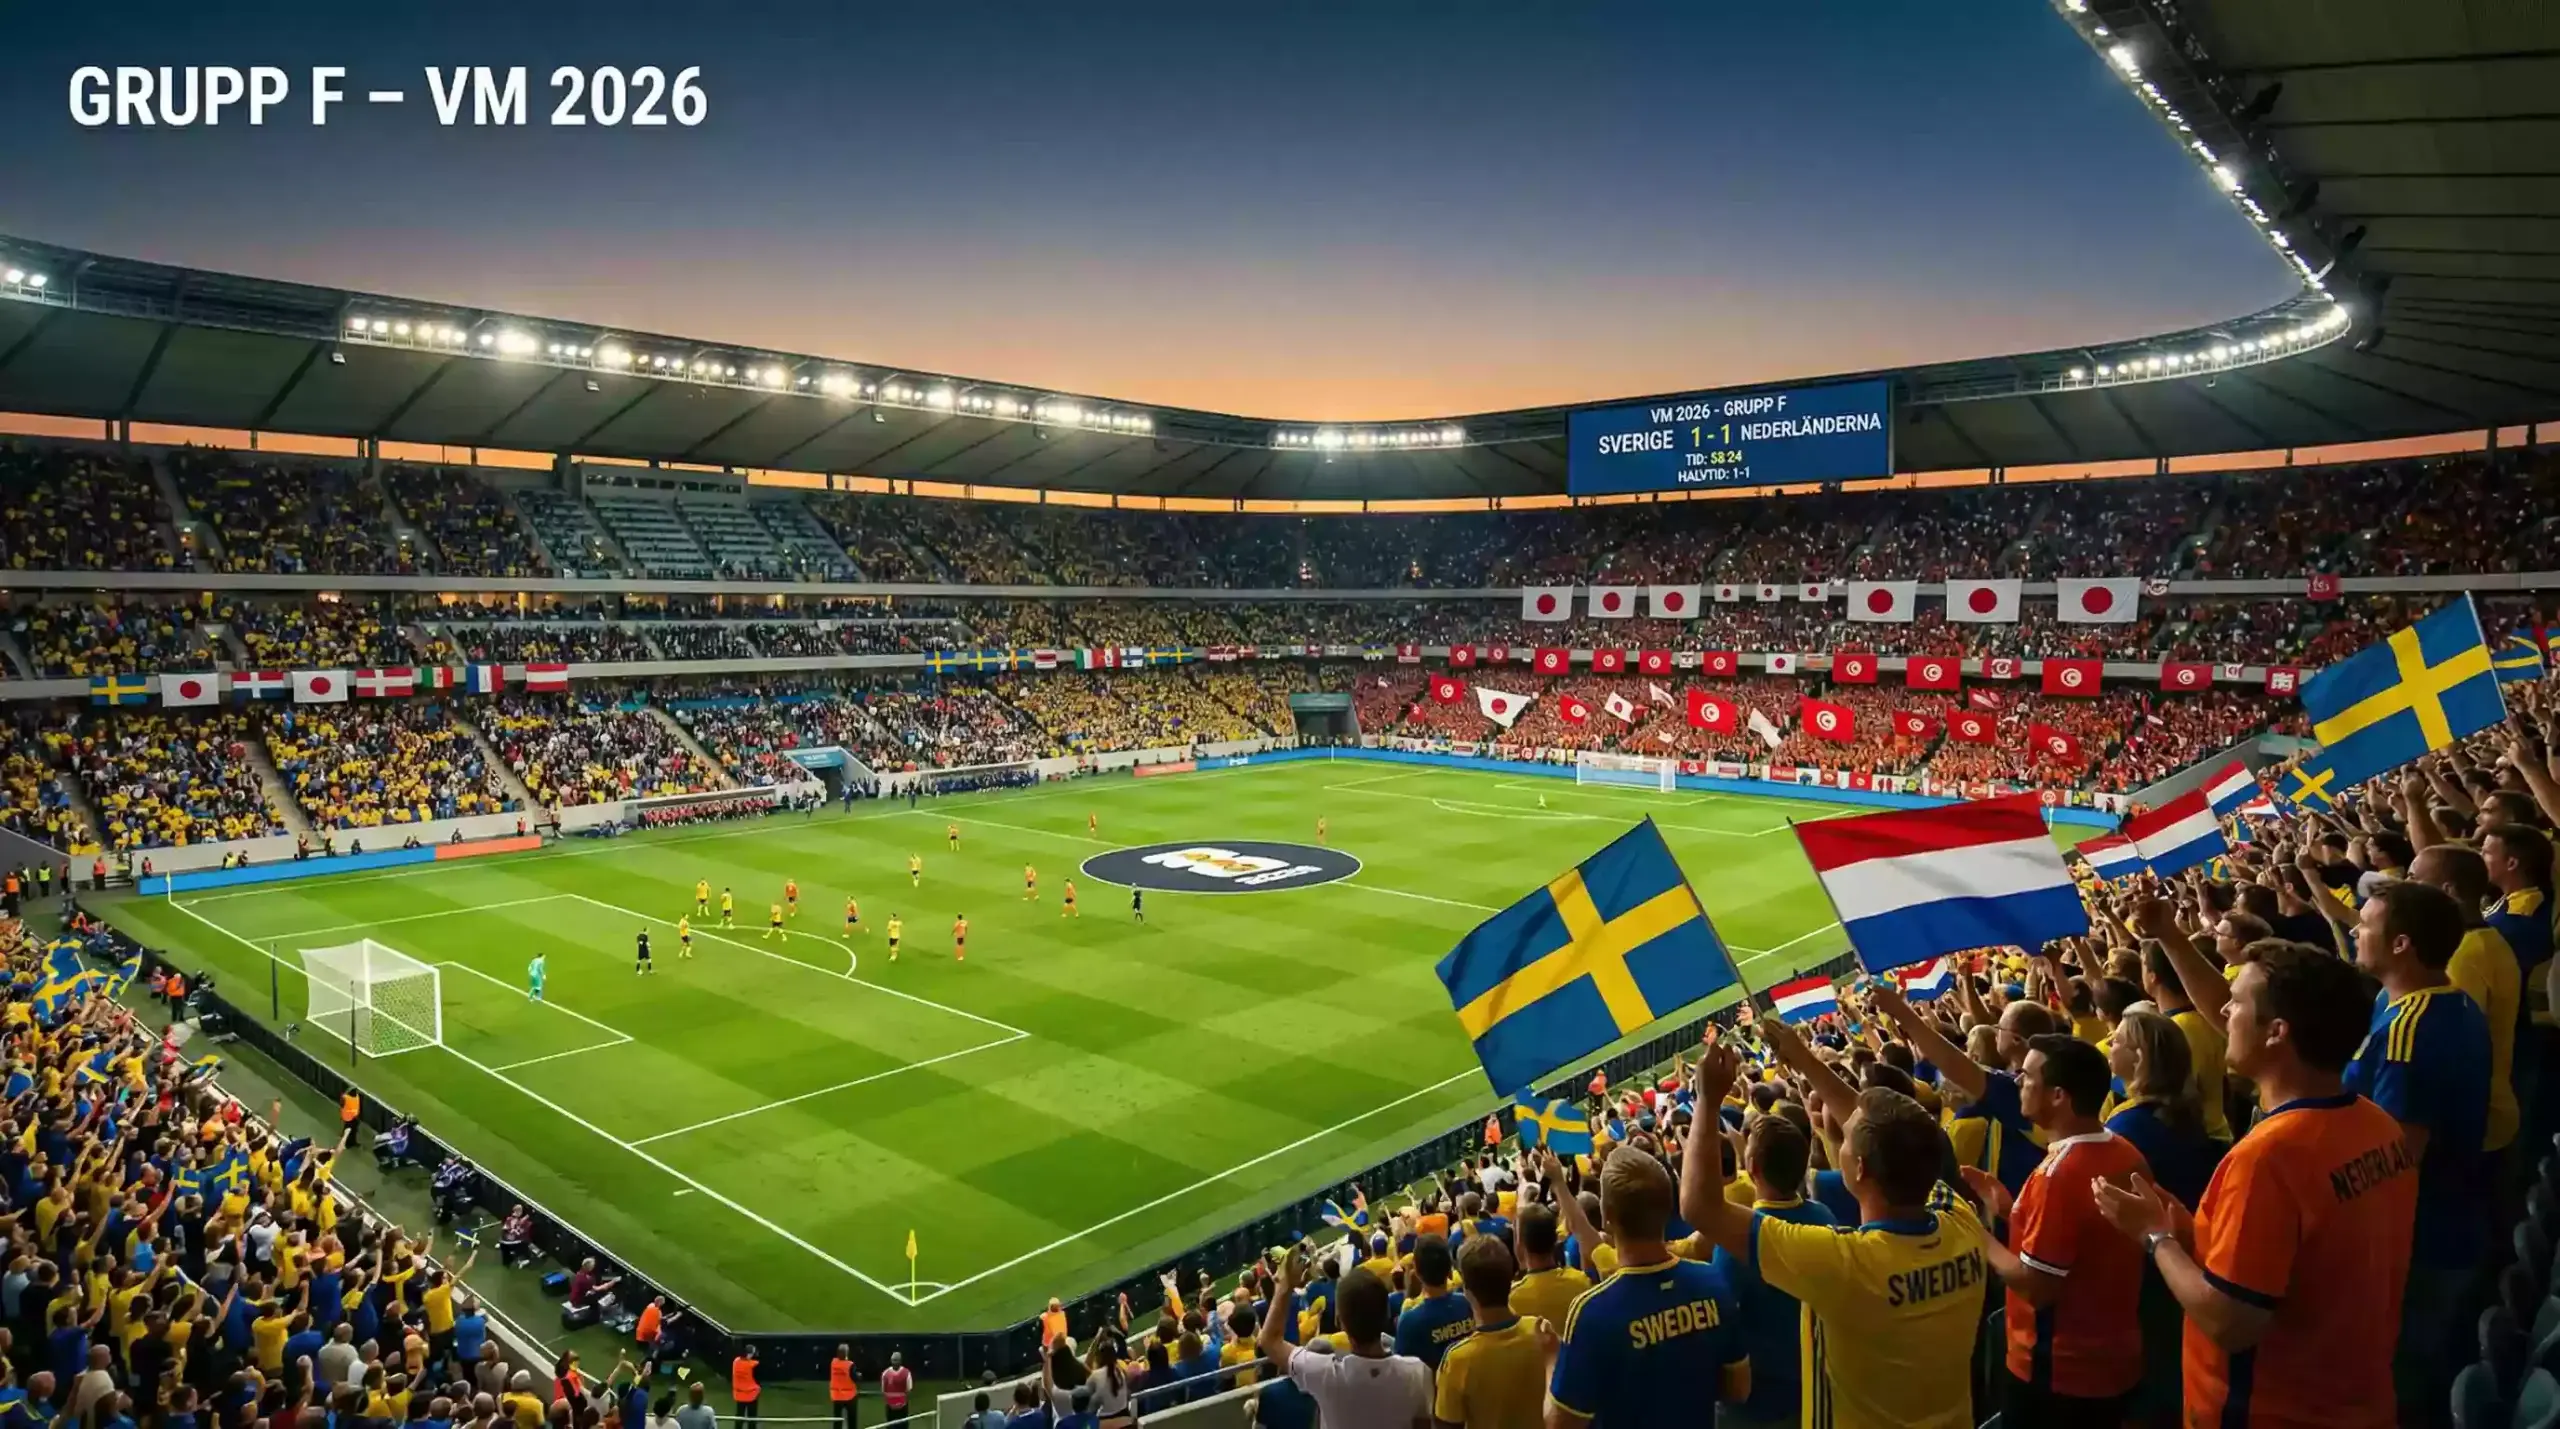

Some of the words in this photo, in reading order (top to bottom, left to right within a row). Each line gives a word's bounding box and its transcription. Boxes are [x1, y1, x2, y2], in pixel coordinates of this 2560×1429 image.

[1650, 407, 1673, 423] VM
[1675, 403, 1711, 421] 2026
[1724, 397, 1775, 416] GRUPP
[1778, 396, 1787, 412] F
[1599, 429, 1674, 454] SVERIGE
[1691, 426, 1700, 448] 1
[1721, 424, 1730, 444] 1
[1741, 412, 1882, 441] NEDERLÄNDERNA
[1678, 468, 1730, 482] HALVTID:
[1733, 466, 1750, 479] 1-1
[1685, 453, 1708, 466] TID:
[1888, 1246, 1983, 1307] SWEDEN
[1629, 1298, 1719, 1349] SWEDEN
